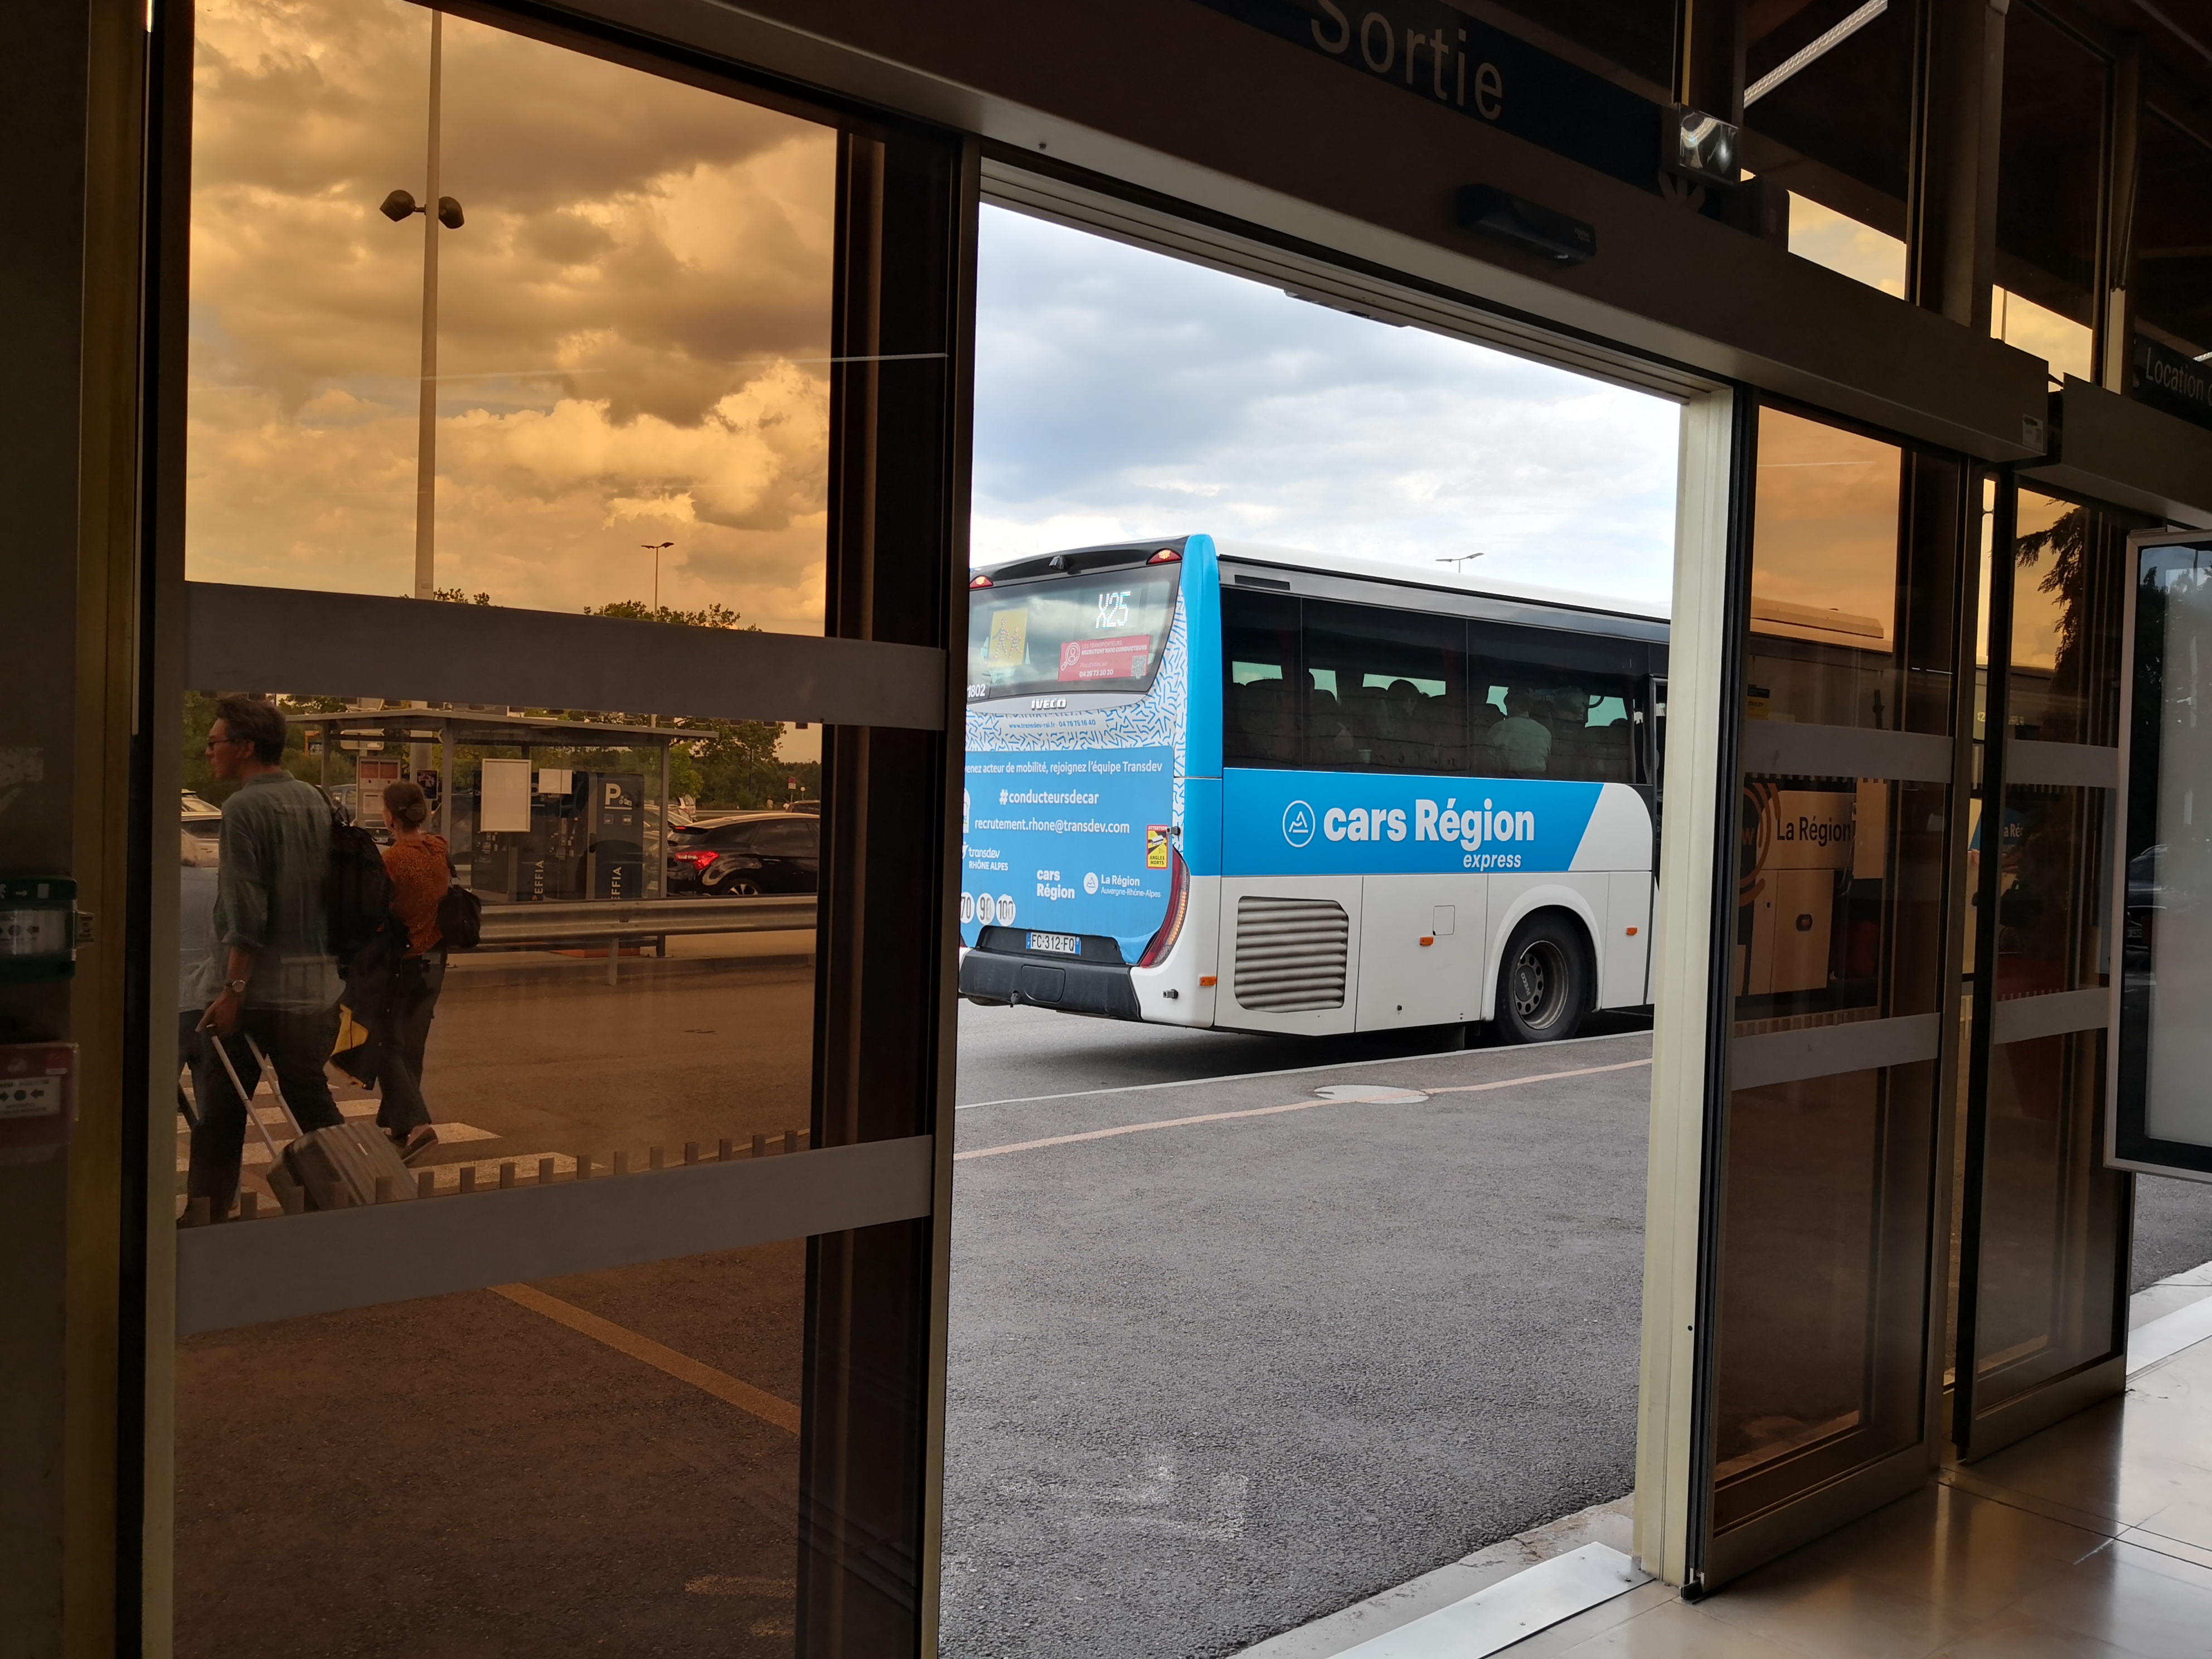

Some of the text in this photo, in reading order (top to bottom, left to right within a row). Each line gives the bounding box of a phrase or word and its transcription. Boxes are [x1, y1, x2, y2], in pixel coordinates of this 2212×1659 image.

[1311, 0, 1503, 120] Sortie
[2146, 347, 2204, 401] Location
[1095, 591, 1131, 628] X25
[1089, 640, 1122, 648] TRANSPORTEURS
[1031, 698, 1067, 711] IVECO
[983, 764, 1005, 773] acteur
[1006, 762, 1015, 773] de
[1016, 762, 1049, 774] mobilité,
[1050, 762, 1086, 775] rejoignez
[1088, 760, 1120, 774] l'équipe
[1122, 760, 1162, 773] Transdev
[605, 783, 621, 806] P
[999, 789, 1099, 805] #conducteursdecar
[974, 818, 1130, 834] recrutement.rhone@transdev.com
[1323, 798, 1535, 851] cars Région
[1777, 816, 1852, 847] La Région
[969, 847, 1001, 858] transdev
[1463, 852, 1521, 871] express
[969, 859, 1008, 871] RHÔNE ALPES
[534, 860, 544, 894] EFFIA
[1036, 869, 1061, 881] cars
[1101, 874, 1141, 887] La Région
[1036, 882, 1075, 901] Région
[1100, 886, 1162, 899] Auvergne-Rhône-Alpes
[998, 900, 1014, 920] 100
[1032, 934, 1075, 952] FC-312-FQ
[1521, 972, 1531, 996] IVECO
